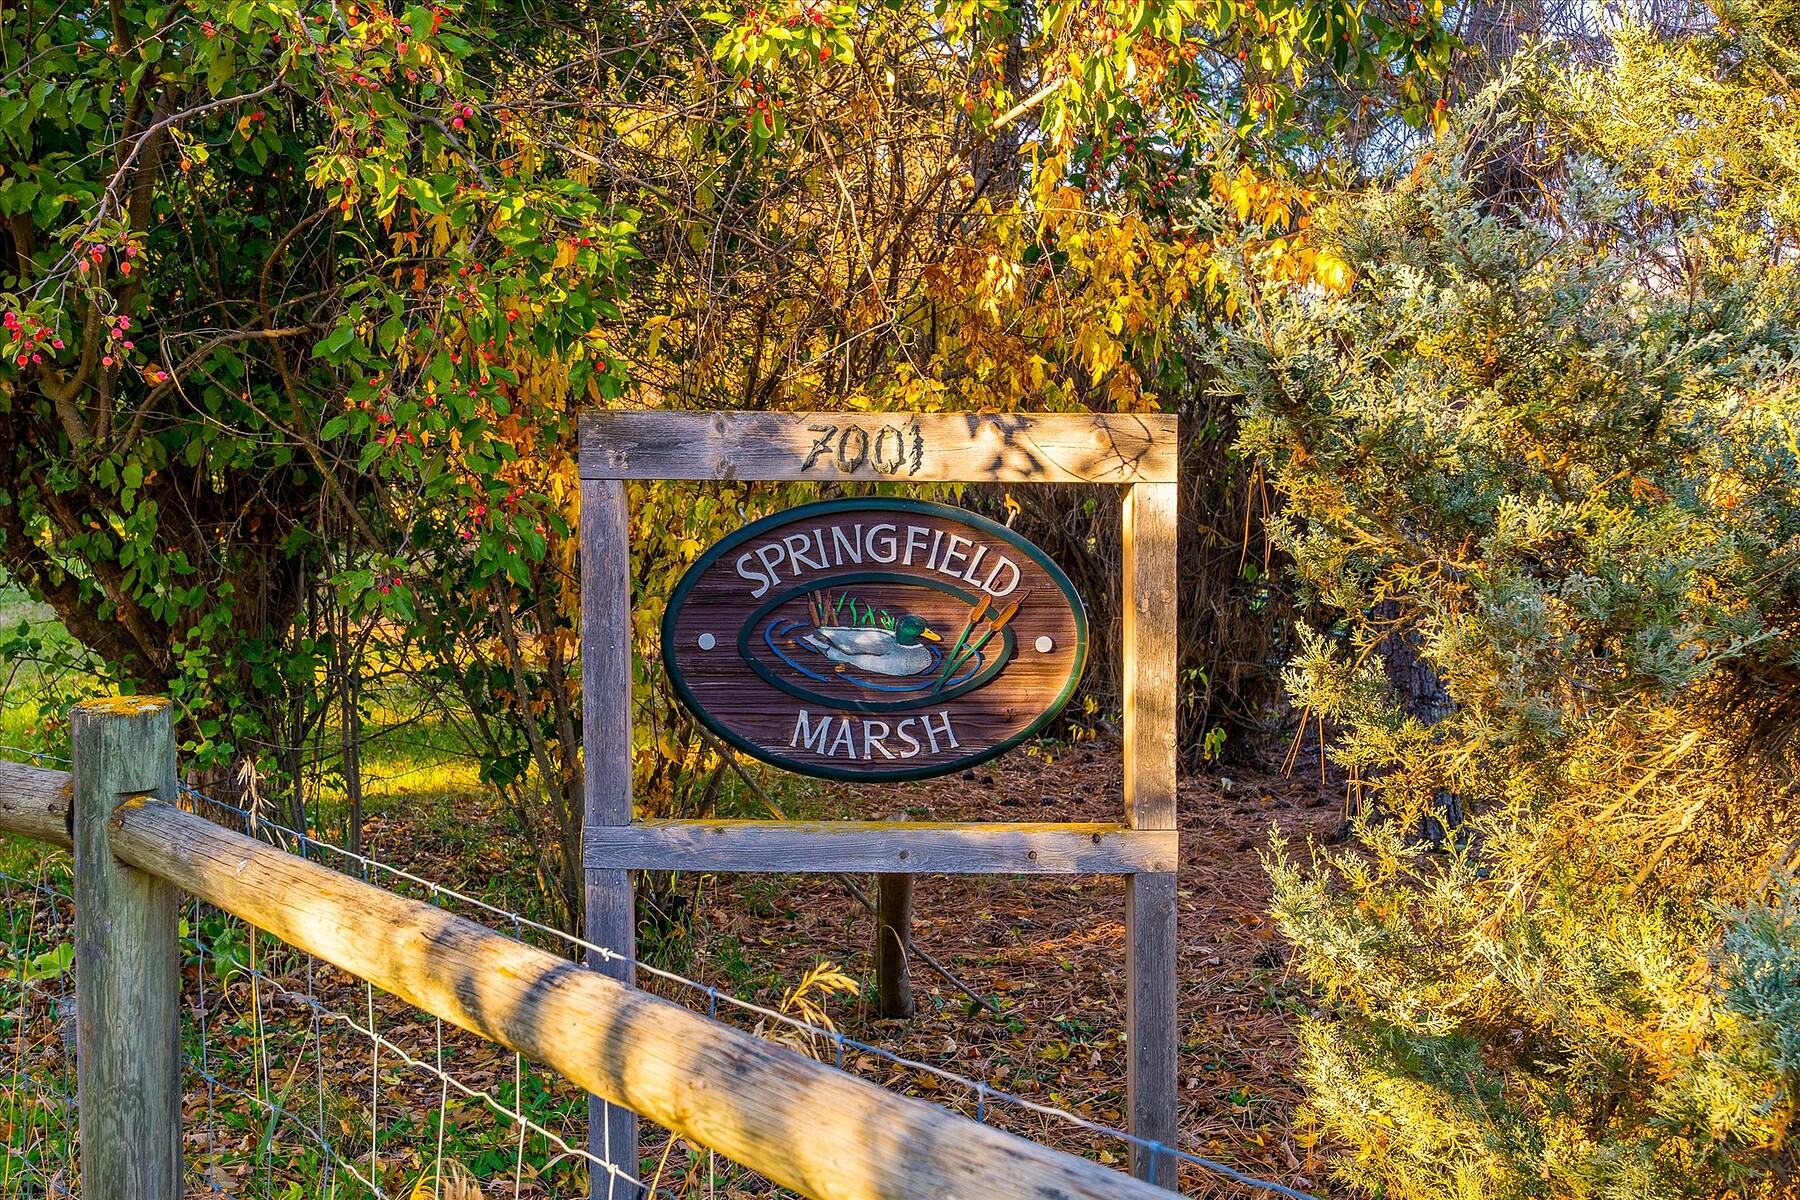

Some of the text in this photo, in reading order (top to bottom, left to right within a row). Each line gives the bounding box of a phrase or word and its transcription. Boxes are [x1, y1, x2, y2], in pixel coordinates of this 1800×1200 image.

[801, 424, 925, 476] 7001
[736, 524, 1021, 599] SPRINGFIELD
[789, 709, 960, 760] MARSH
